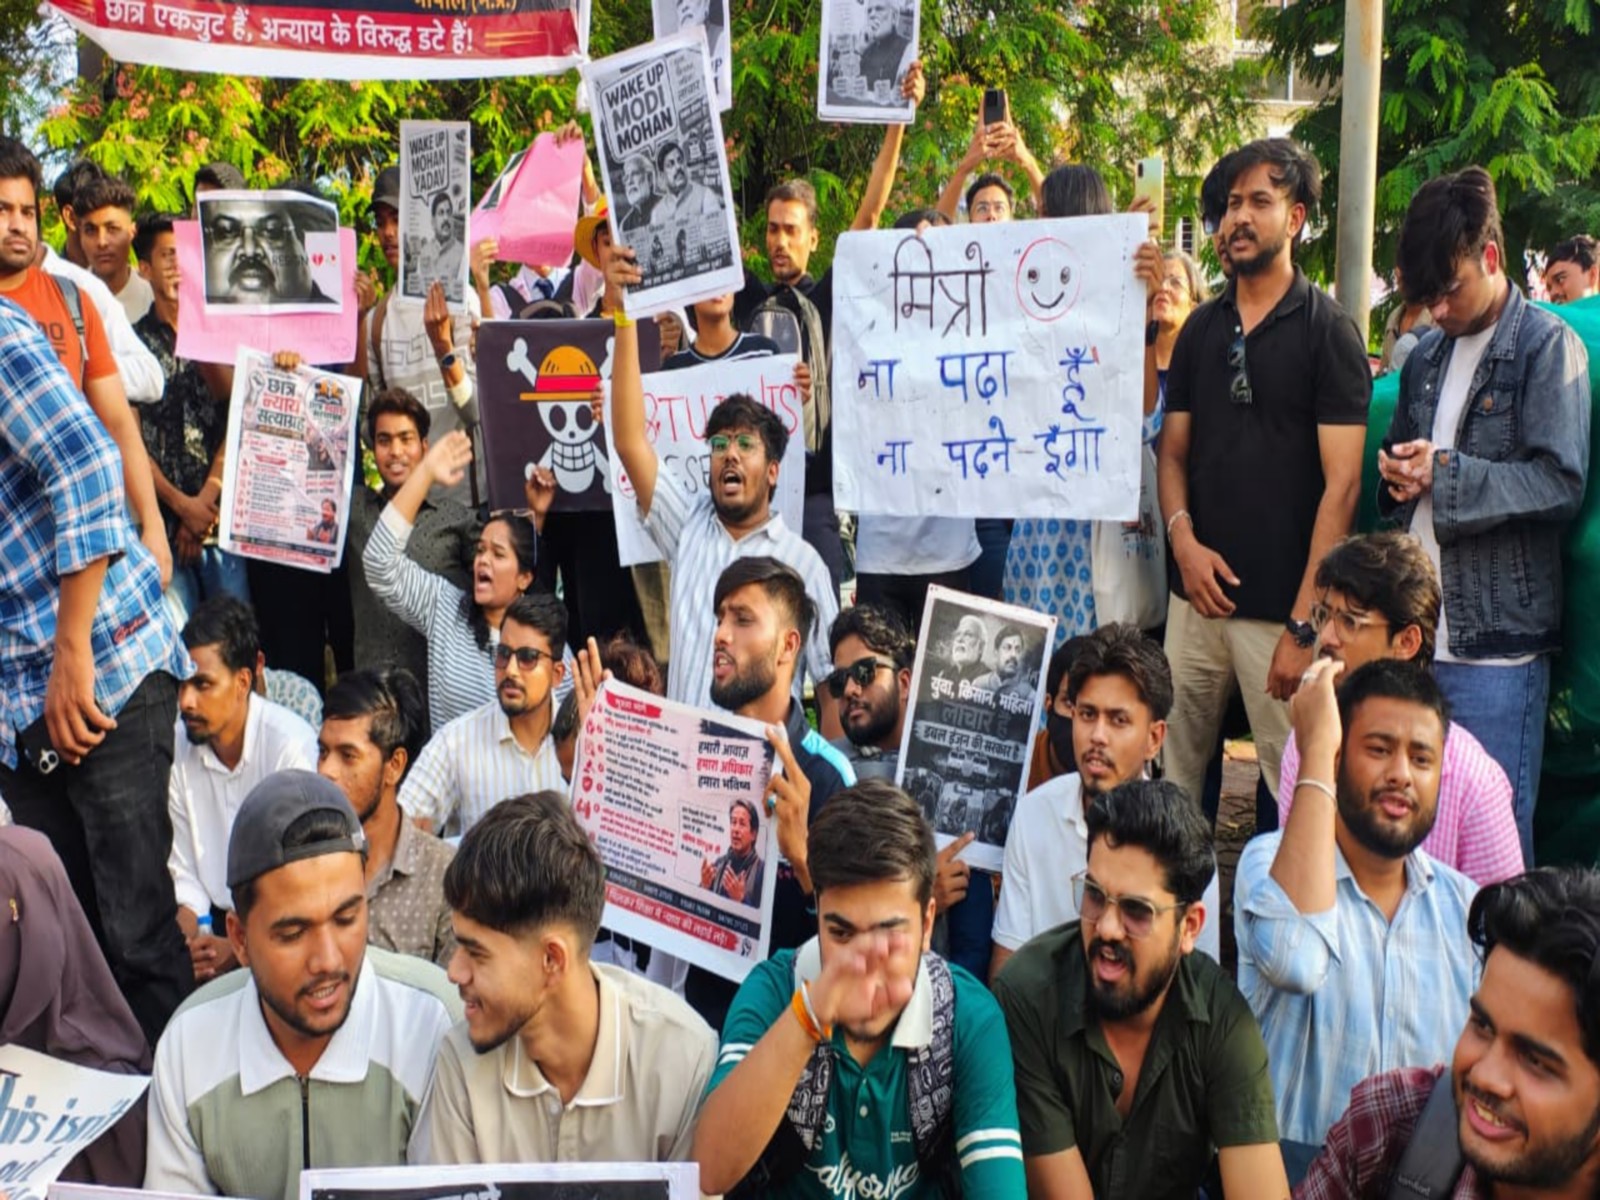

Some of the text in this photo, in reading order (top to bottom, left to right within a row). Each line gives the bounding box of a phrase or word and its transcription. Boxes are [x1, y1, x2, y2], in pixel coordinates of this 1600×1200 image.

[105, 0, 147, 25] छात्र
[153, 4, 225, 42] एकजुट
[261, 17, 325, 44] अन्याय
[330, 13, 351, 46] के
[356, 14, 412, 53] विरुद्ध
[417, 19, 445, 50] डटे
[605, 73, 645, 109] WAKE
[646, 63, 664, 87] UP
[612, 84, 665, 132] MODI
[409, 131, 446, 155] WAKE UP
[617, 107, 673, 154] MOHAN
[411, 148, 446, 174] MOHAN
[414, 168, 445, 193] YADAV
[268, 378, 296, 397] छात्र
[858, 358, 902, 398] ना
[262, 391, 300, 415] न्याय
[877, 440, 914, 475] ना
[931, 670, 955, 699] युवा,
[958, 679, 996, 709] किसान,
[999, 691, 1035, 717] महिला
[923, 724, 947, 743] डबल
[698, 739, 721, 755] हमारी
[697, 757, 753, 777] हमारा अधिकार
[698, 775, 751, 791] हमारा भविष्य
